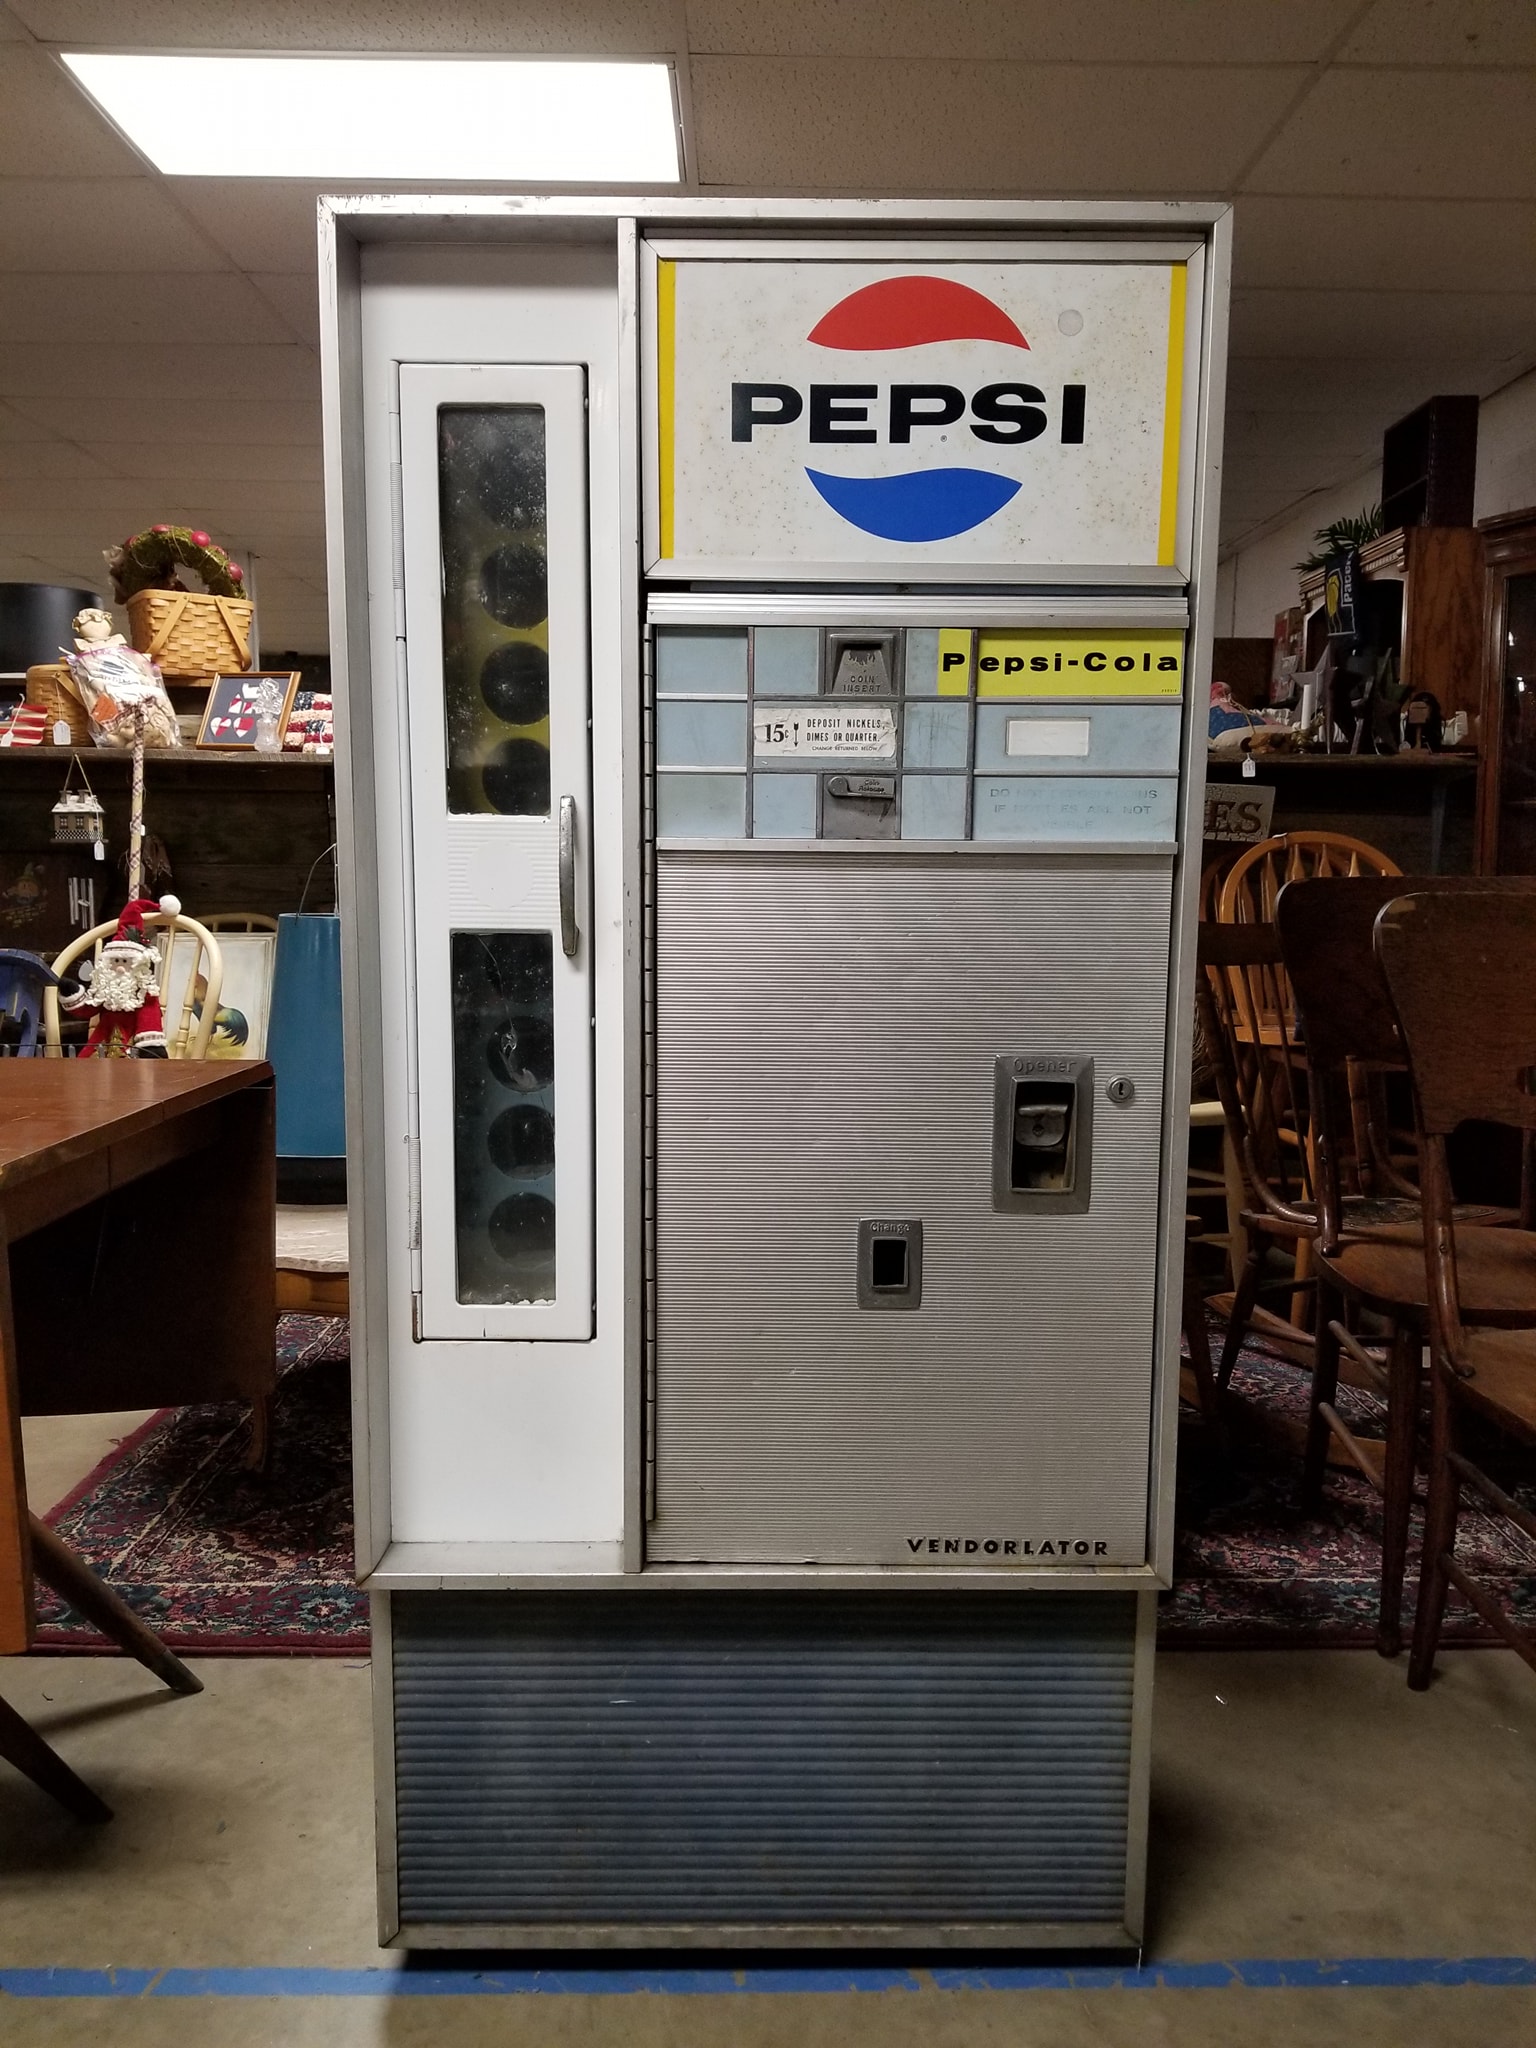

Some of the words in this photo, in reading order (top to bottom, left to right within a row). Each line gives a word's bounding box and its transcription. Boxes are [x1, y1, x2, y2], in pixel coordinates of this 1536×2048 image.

[731, 382, 1087, 445] PEPSI
[942, 651, 1179, 675] Pepsi-Cola
[850, 675, 875, 683] COIN
[843, 684, 881, 693] INSERT
[807, 718, 841, 728] DEPOSIT
[846, 718, 885, 730] NICKELS,
[806, 732, 829, 742] DIMES
[833, 732, 843, 742] OR
[845, 732, 880, 742] QUARTER.
[990, 788, 1010, 797] DO
[994, 804, 1006, 813] IF
[1122, 805, 1152, 814] NOT
[1012, 1058, 1077, 1073] Opener
[869, 1221, 911, 1233] Change
[905, 1538, 1109, 1556] VENDORLATOR
